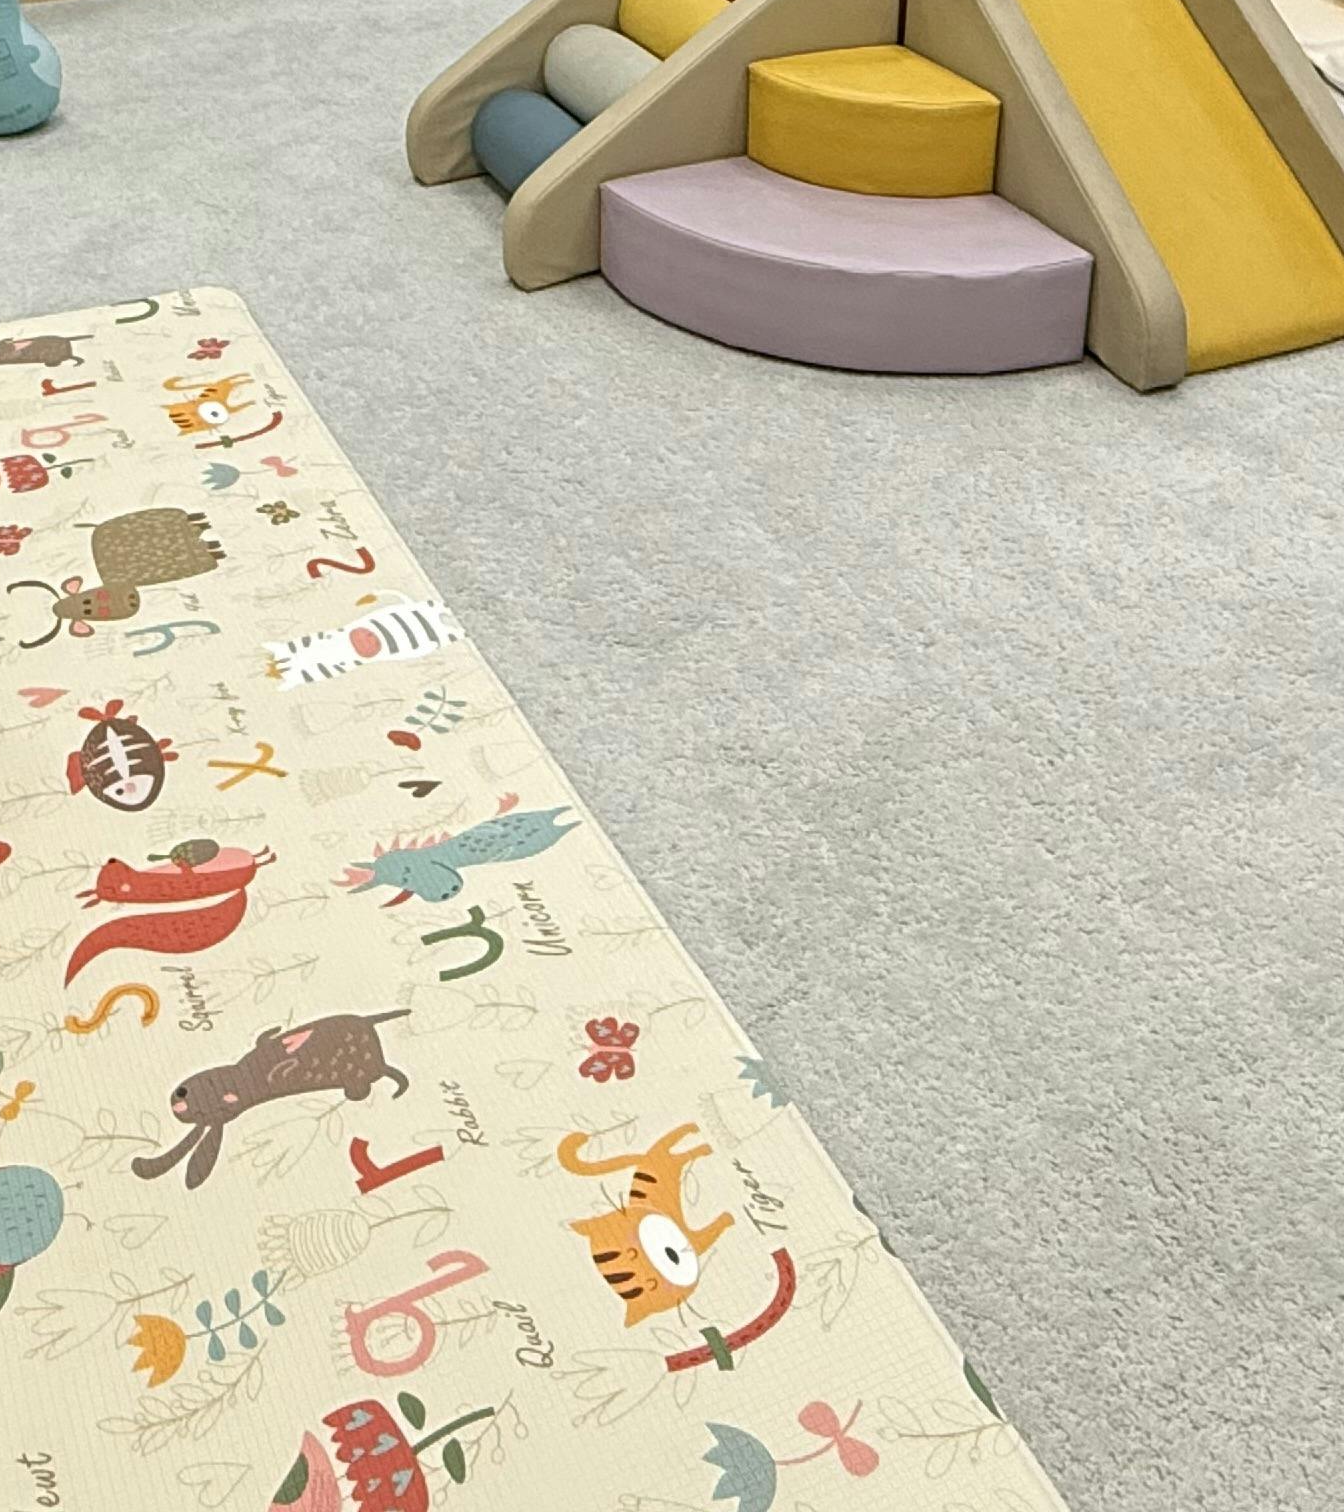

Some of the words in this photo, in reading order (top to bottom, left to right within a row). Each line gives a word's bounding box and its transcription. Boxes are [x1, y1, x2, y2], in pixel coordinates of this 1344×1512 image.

[512, 880, 574, 956] Unicorn
[160, 965, 224, 1032] Squirrel
[439, 1080, 490, 1148] Rabbit
[732, 1157, 789, 1236] Tiger
[491, 1299, 555, 1369] Quail
[14, 1451, 61, 1512] ewt
